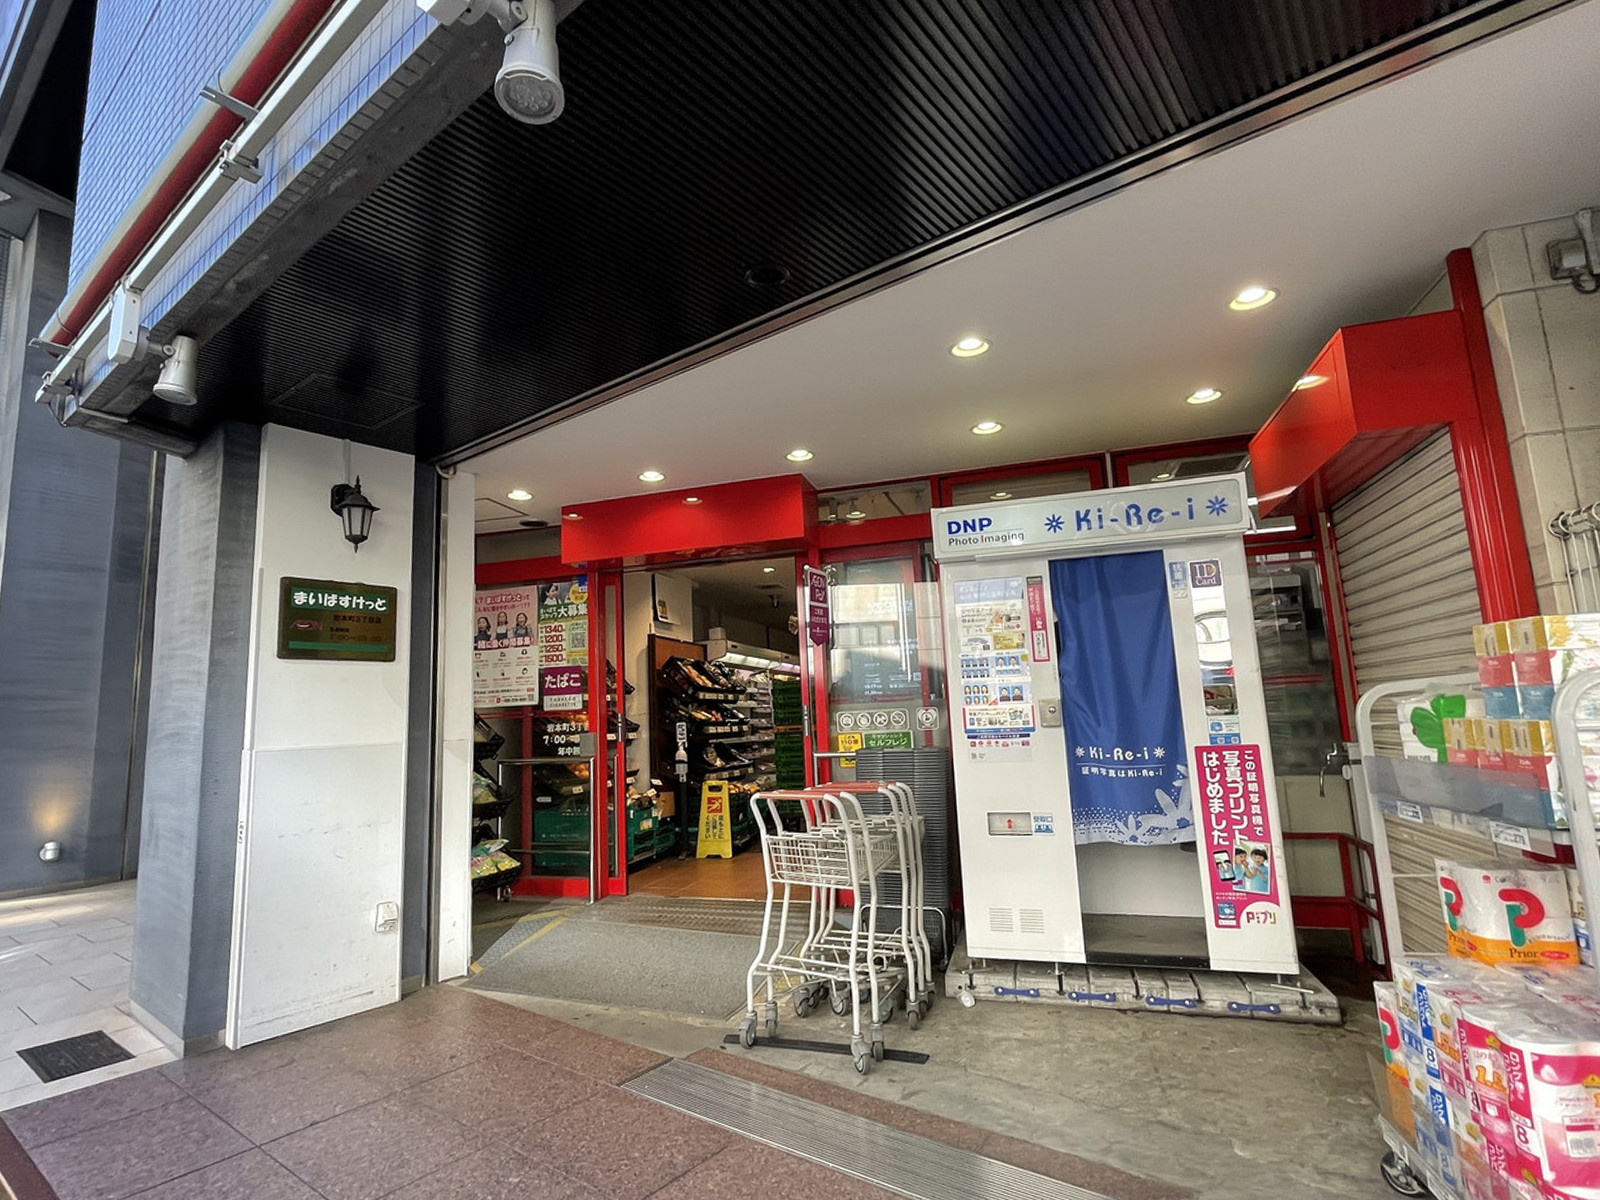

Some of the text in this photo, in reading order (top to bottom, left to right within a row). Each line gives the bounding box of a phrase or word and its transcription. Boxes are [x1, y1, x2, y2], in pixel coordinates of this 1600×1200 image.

[1076, 497, 1194, 532] Ki-Re-i
[947, 517, 992, 535] DNP
[948, 532, 1024, 546] Photo Imaging
[1193, 563, 1216, 577] ID
[1195, 576, 1216, 586] Card
[293, 591, 387, 611] まいばすけっと
[545, 673, 581, 689] たばこ
[869, 737, 907, 747] セルフレジ
[1089, 746, 1149, 761] Ki-Re-i
[1202, 751, 1229, 846] はじめました
[1222, 750, 1248, 846] 写真プリント
[1244, 750, 1263, 836] この証明写真機で
[1509, 948, 1538, 958] Prior
[1427, 1048, 1435, 1062] 8
[1516, 1125, 1529, 1145] 8
